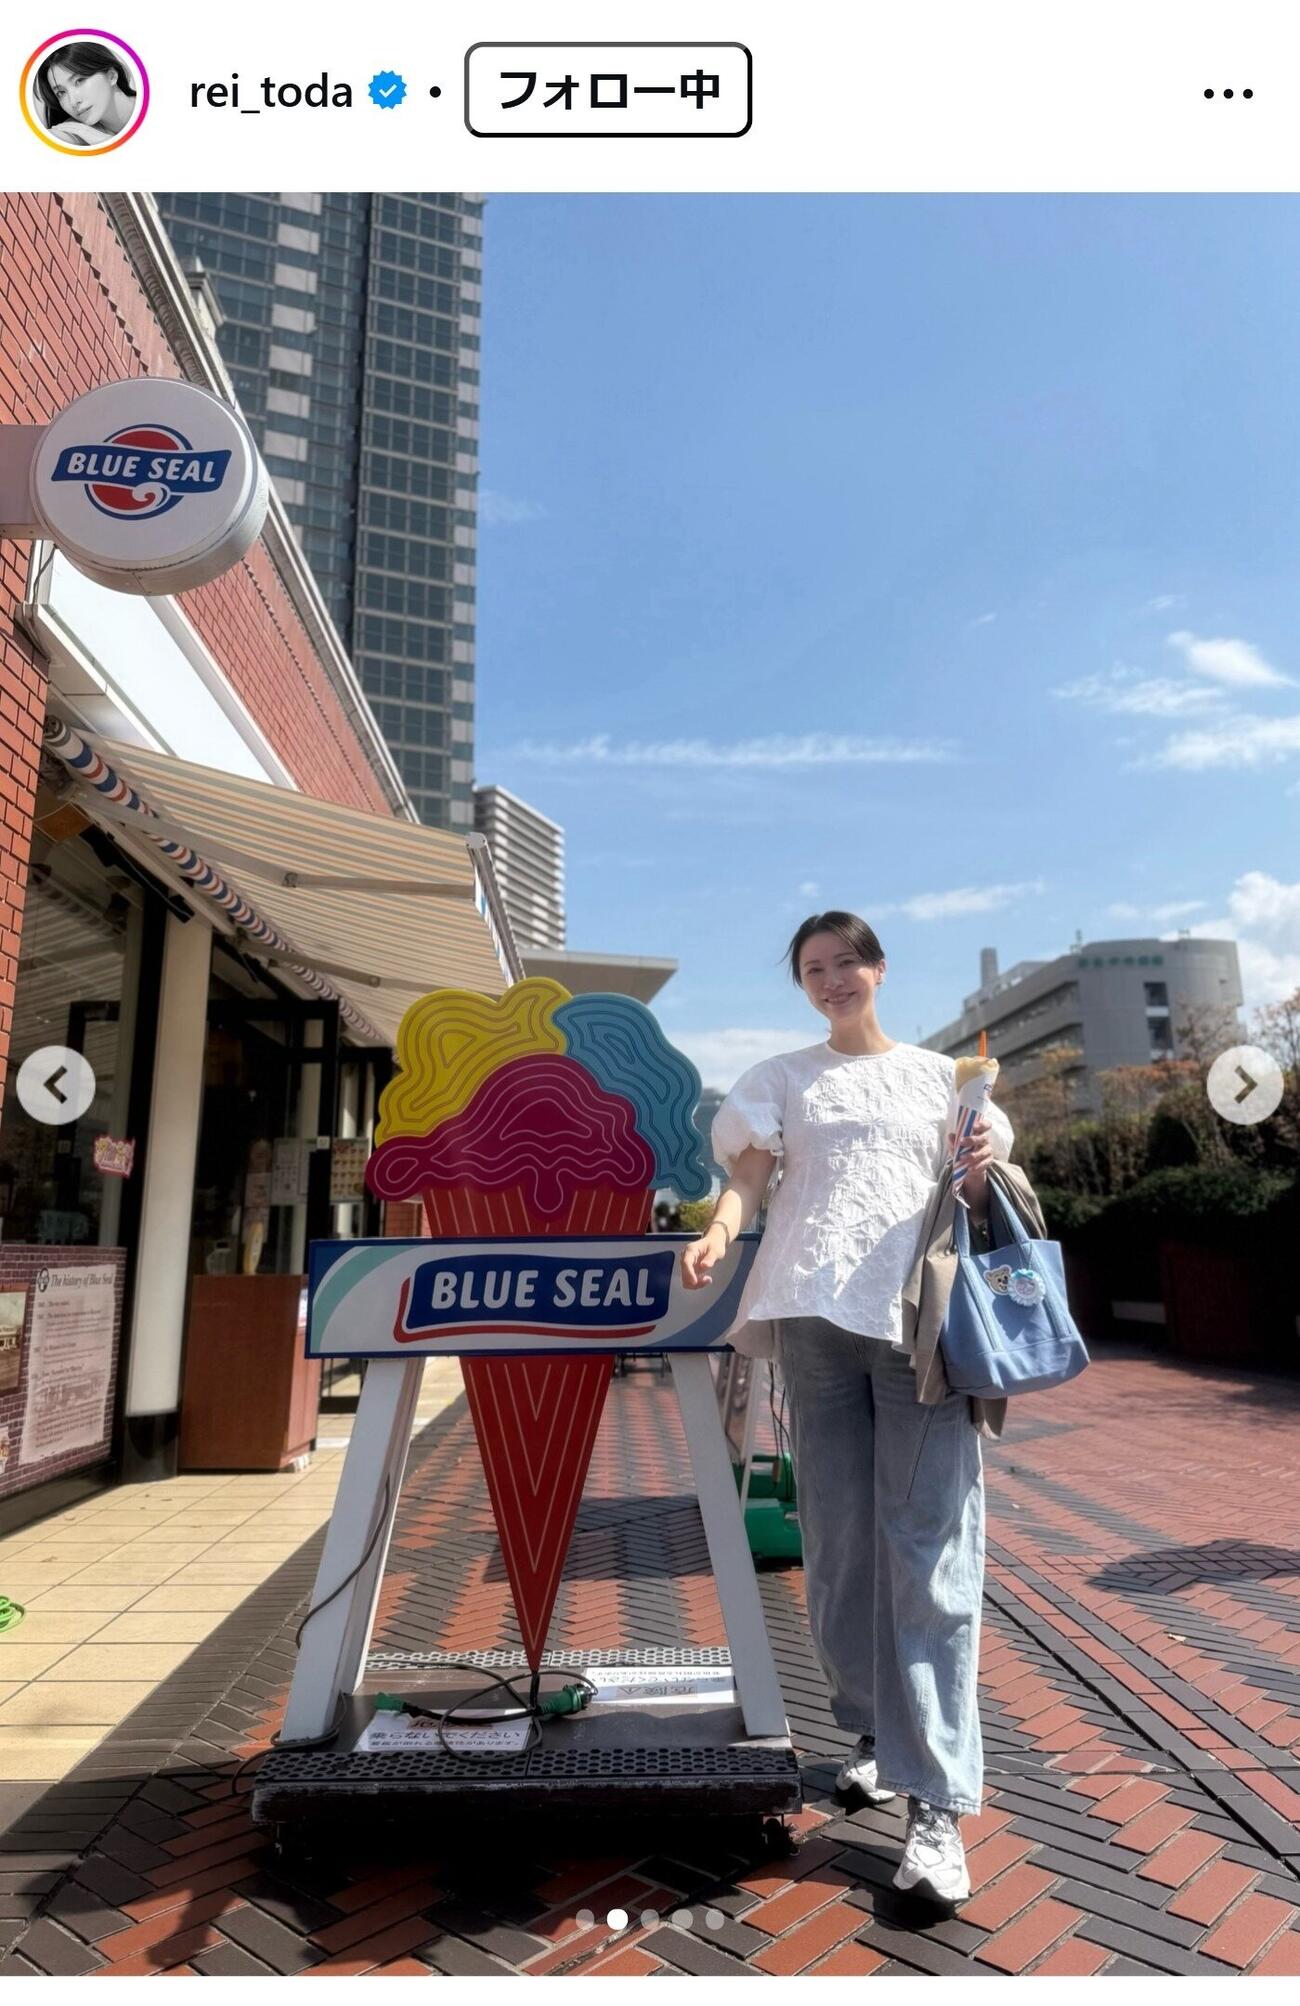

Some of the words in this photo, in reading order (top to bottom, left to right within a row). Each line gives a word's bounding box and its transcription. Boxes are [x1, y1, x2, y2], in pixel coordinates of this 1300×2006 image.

[67, 452, 139, 478] BLUE
[148, 457, 216, 483] SEAL
[431, 1270, 539, 1309] BLUE
[553, 1268, 655, 1308] SEAL
